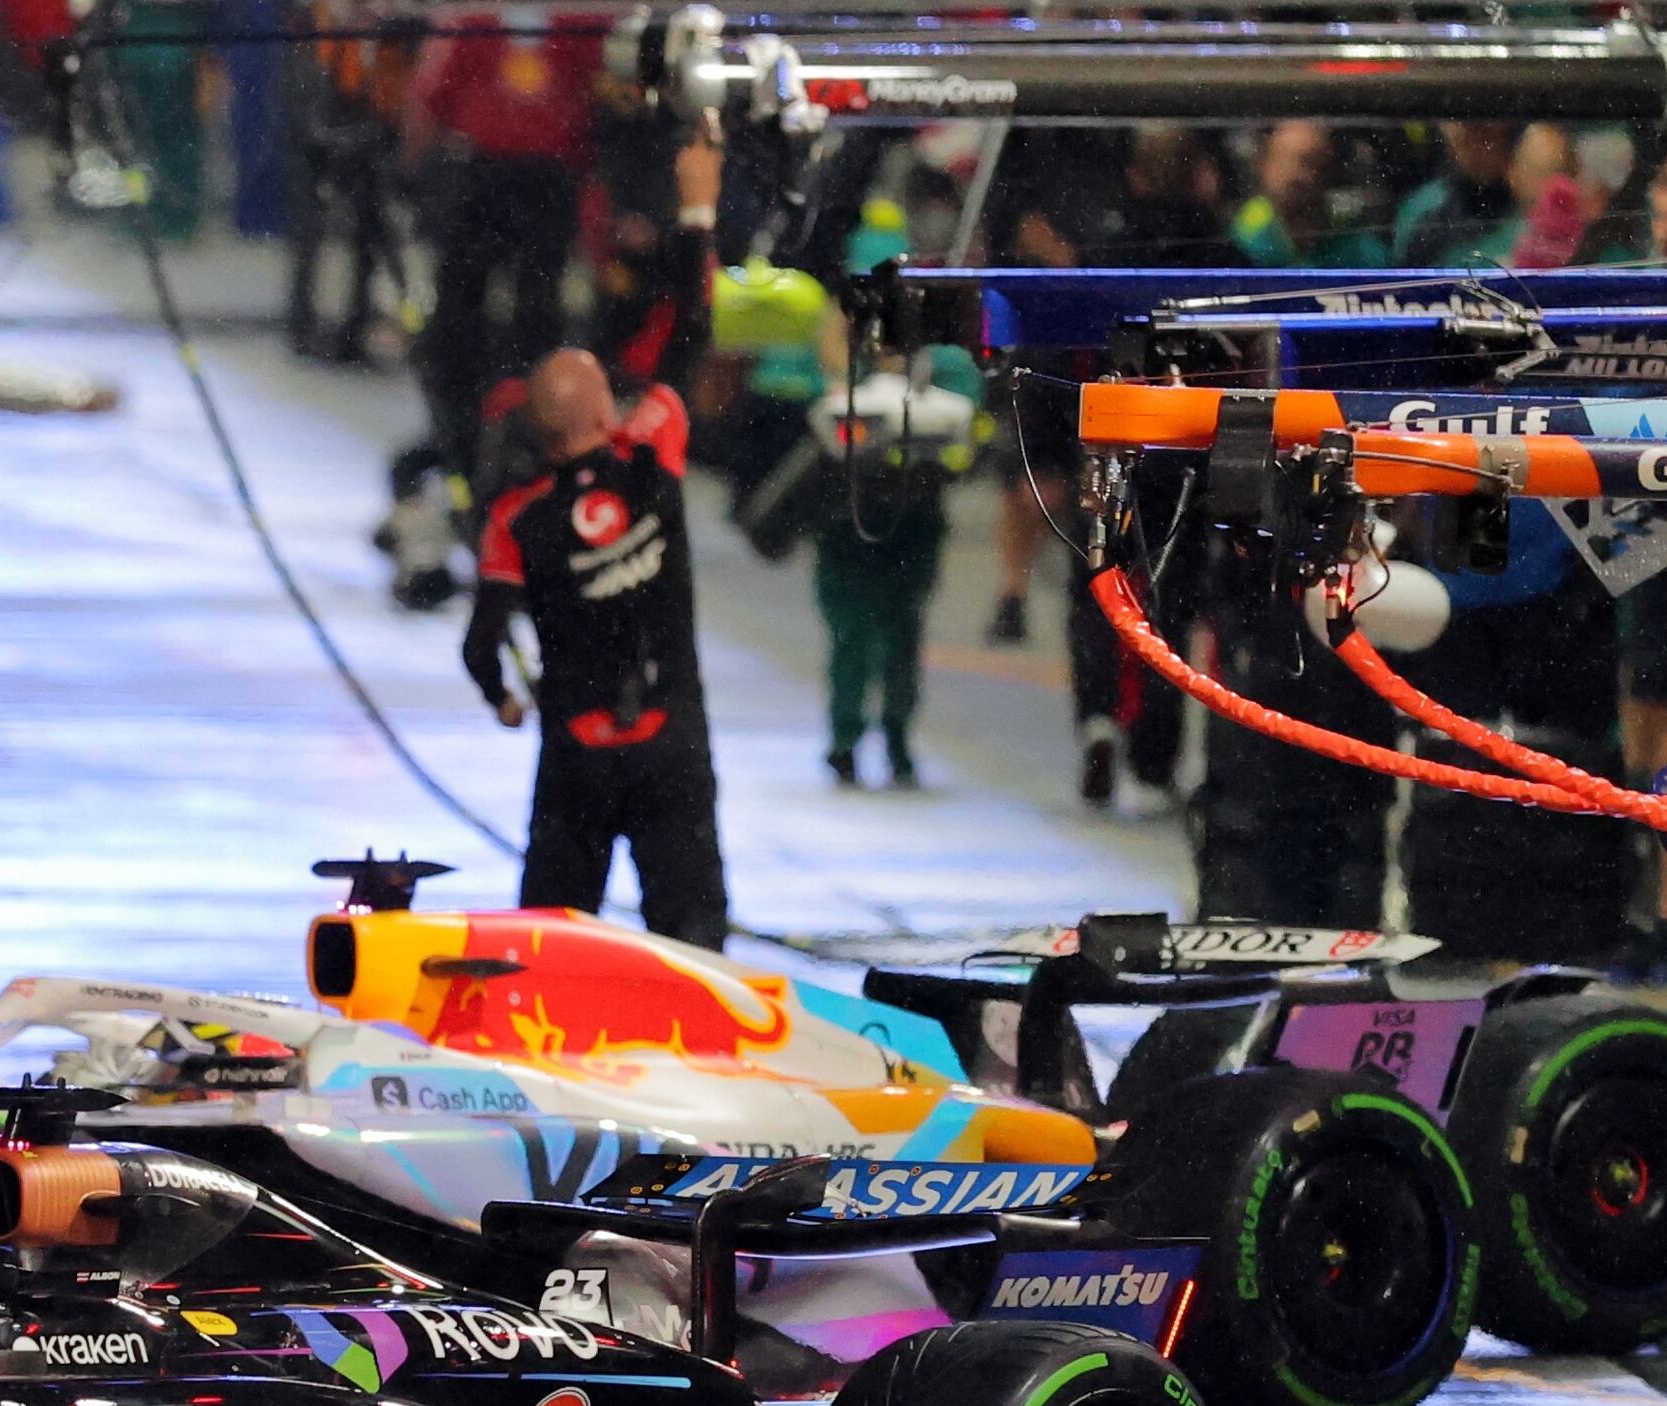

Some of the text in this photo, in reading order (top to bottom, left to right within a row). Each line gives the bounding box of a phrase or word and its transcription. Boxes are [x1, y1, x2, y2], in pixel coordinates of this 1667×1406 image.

[419, 1087, 528, 1114] Cash App
[675, 1163, 1080, 1215] AASSIAN
[539, 1268, 608, 1312] 23
[992, 1264, 1169, 1308] KOMATSU
[40, 1332, 149, 1365] kraken
